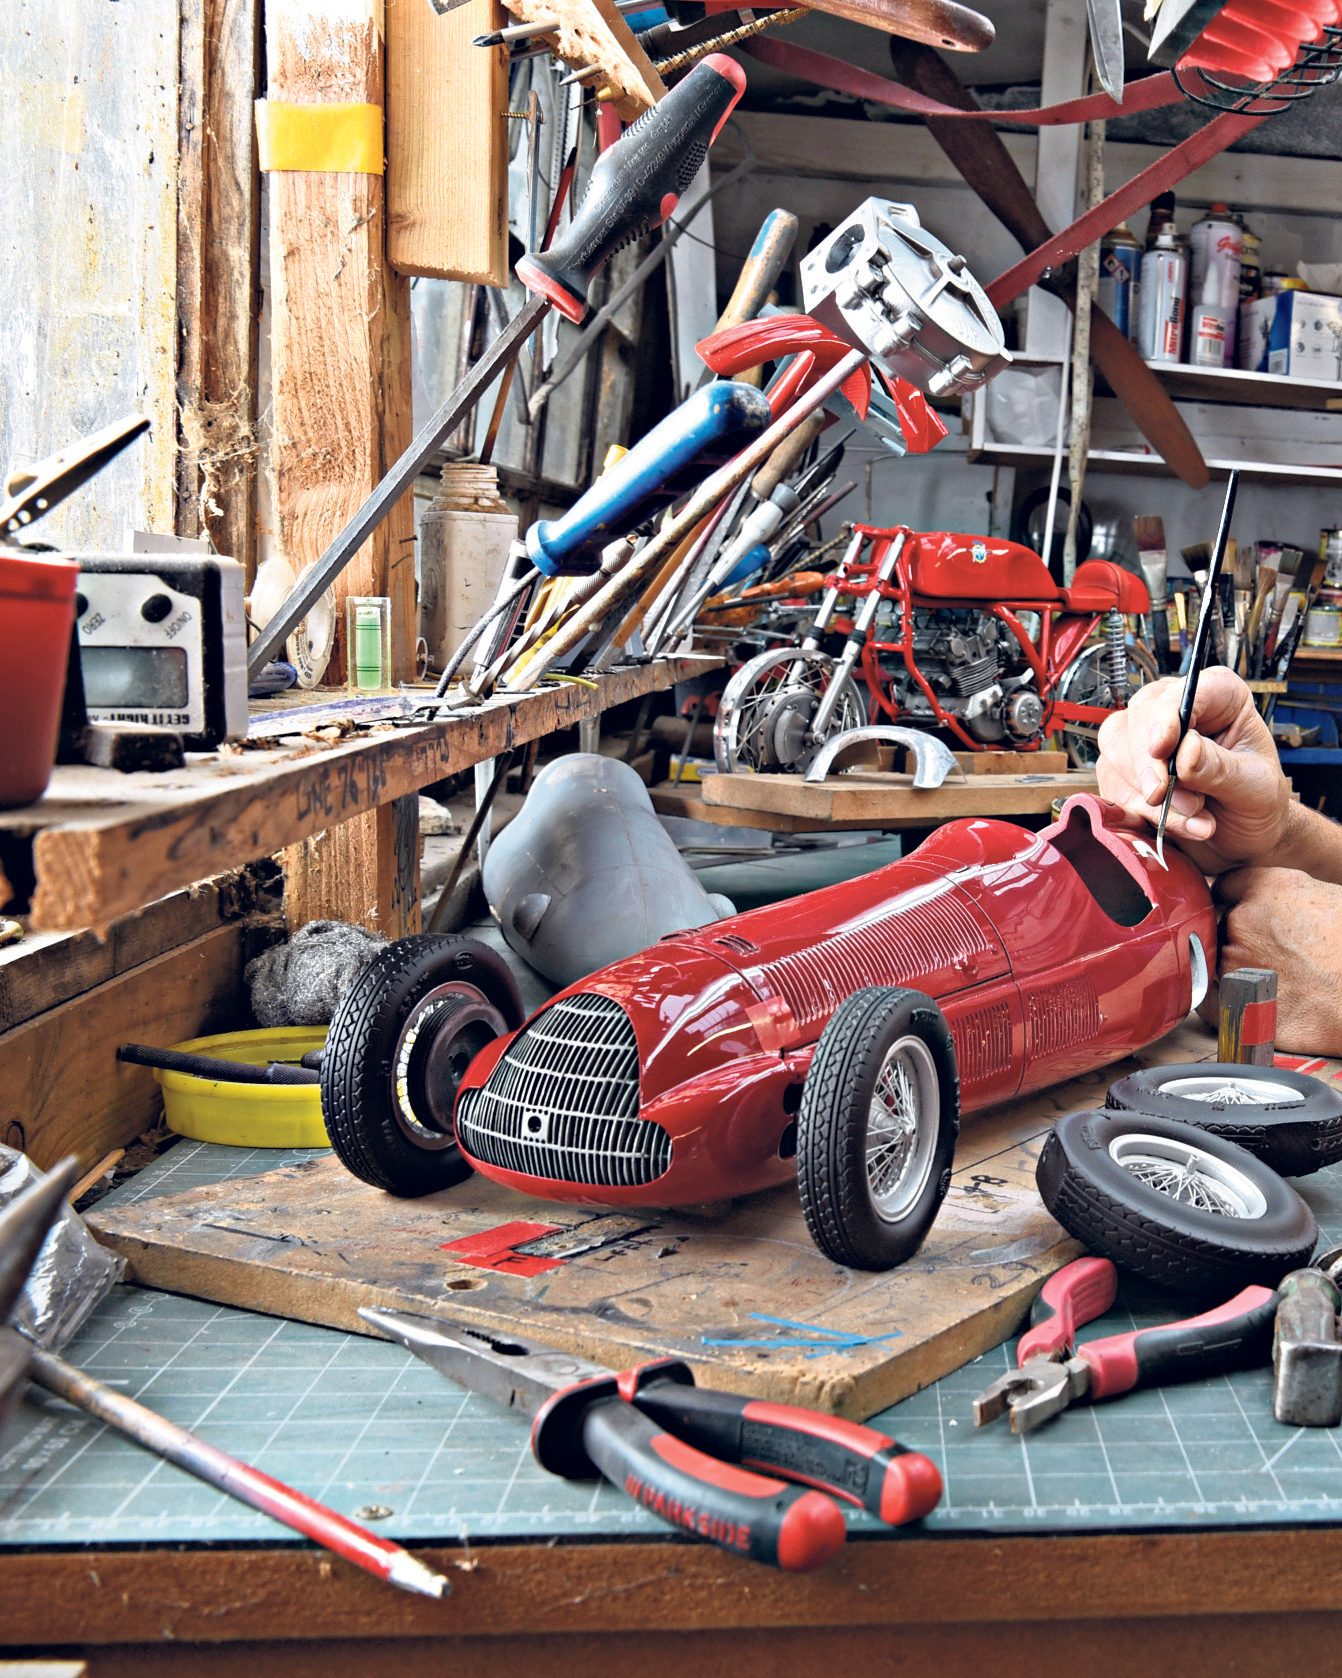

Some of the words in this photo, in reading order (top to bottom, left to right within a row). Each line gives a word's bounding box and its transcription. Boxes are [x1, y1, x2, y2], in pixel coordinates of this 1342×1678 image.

[648, 112, 674, 142] GmbH
[1167, 296, 1180, 355] MitreBond
[82, 612, 106, 636] ZERO
[162, 611, 192, 640] ON/OFF
[152, 713, 164, 725] IT
[168, 713, 190, 725] GET
[643, 1487, 751, 1551] PARKSIDE
